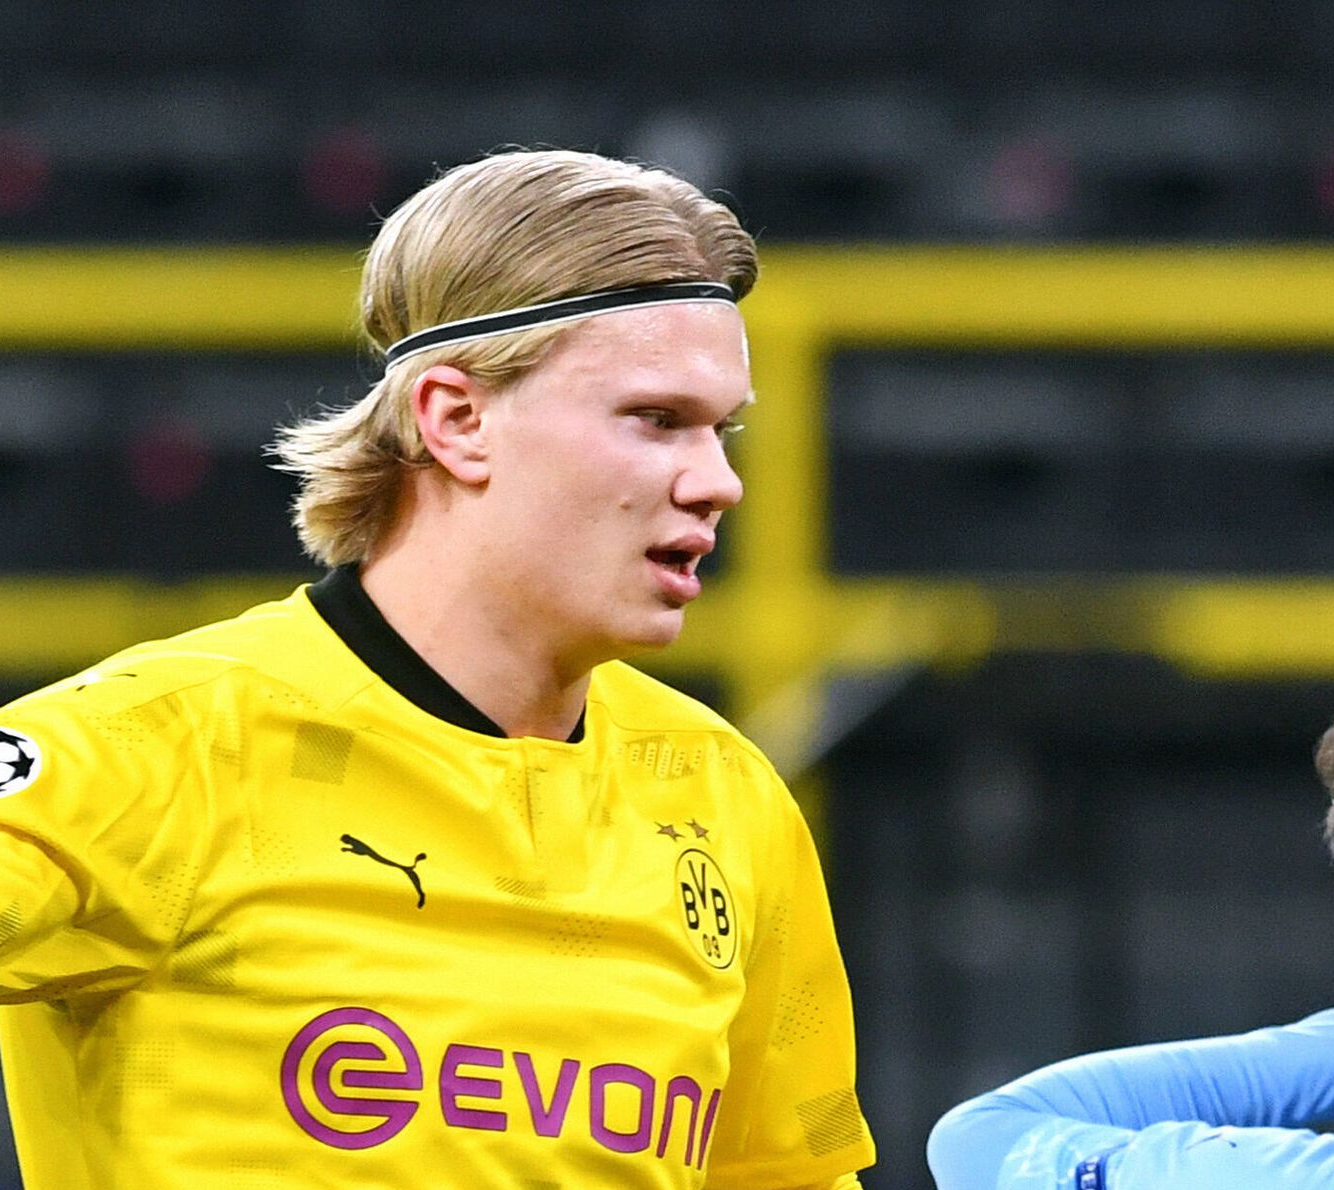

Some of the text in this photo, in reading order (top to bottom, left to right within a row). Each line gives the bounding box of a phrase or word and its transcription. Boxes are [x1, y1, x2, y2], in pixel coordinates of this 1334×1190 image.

[680, 860, 730, 937] BVB
[702, 933, 722, 959] 09
[439, 1043, 722, 1171] EVONI
